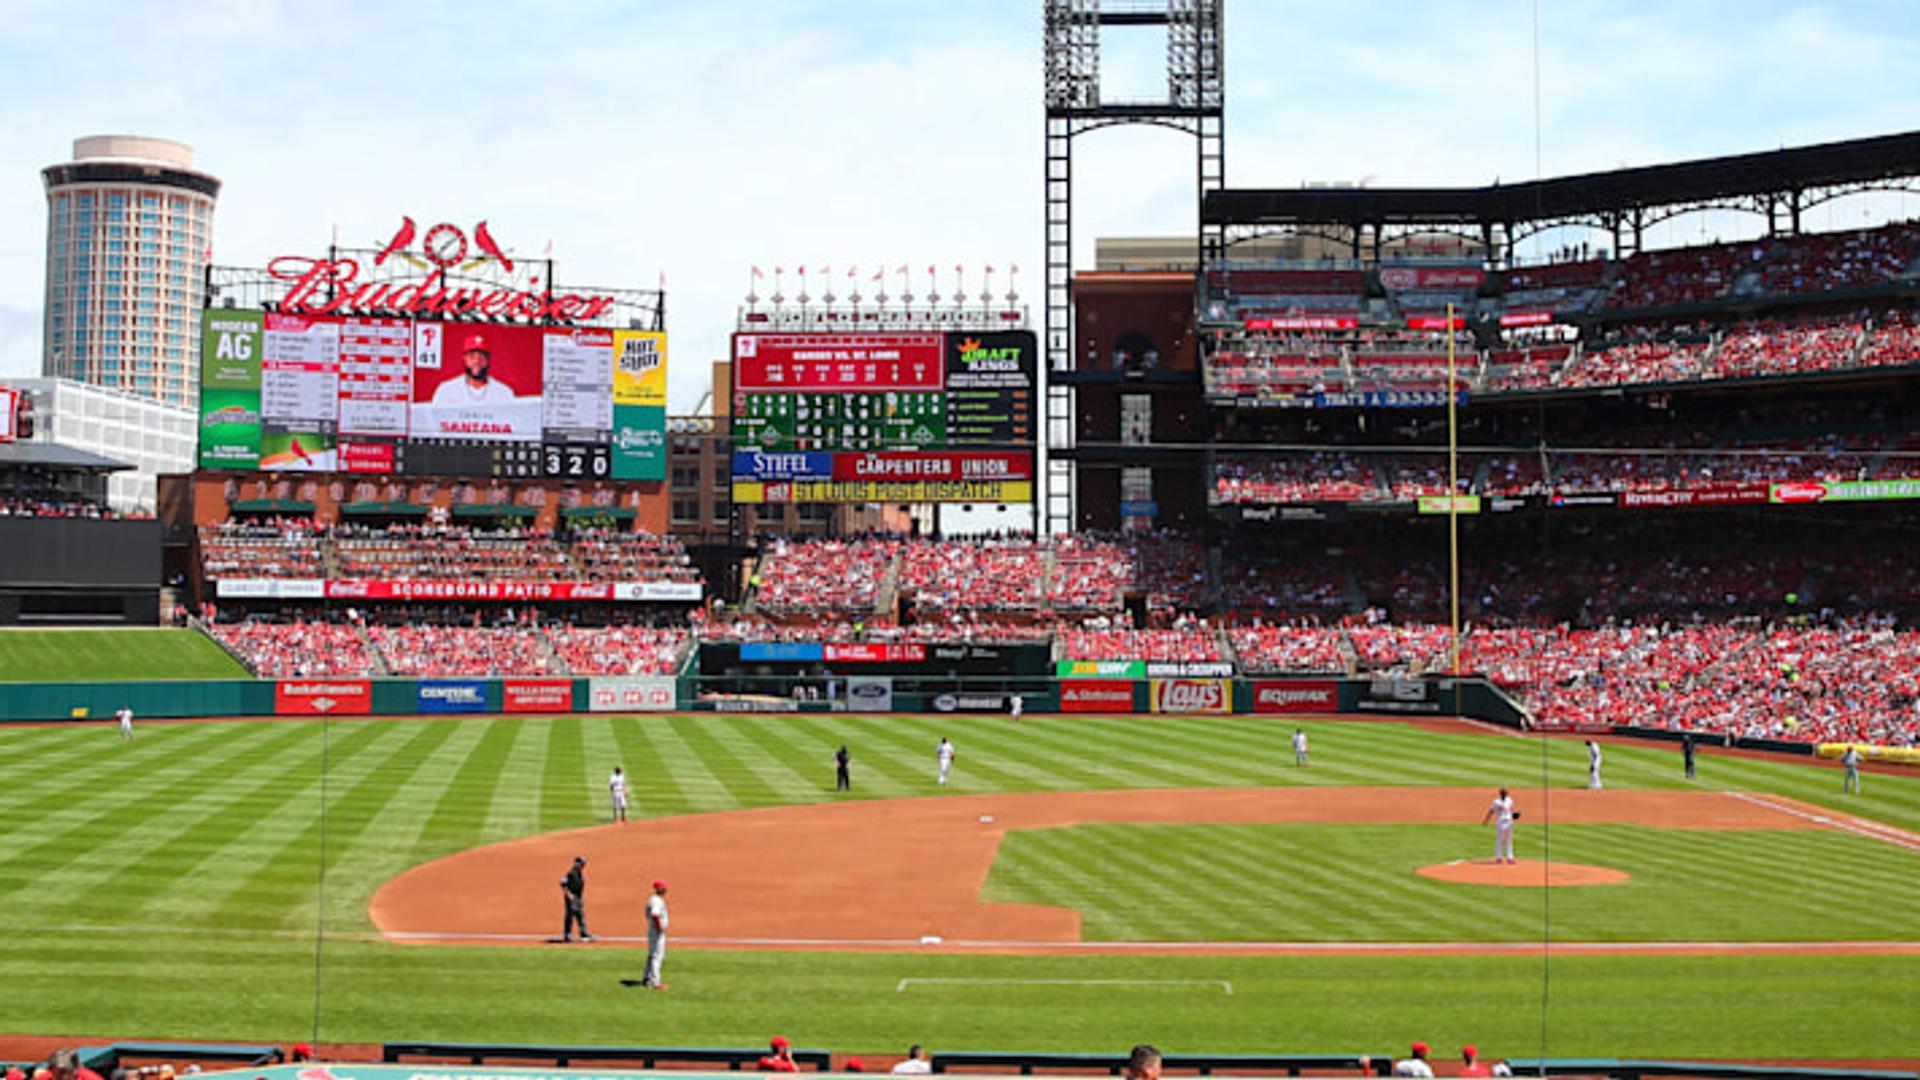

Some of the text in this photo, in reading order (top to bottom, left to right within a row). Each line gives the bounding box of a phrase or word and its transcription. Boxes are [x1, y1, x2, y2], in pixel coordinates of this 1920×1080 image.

[267, 257, 614, 321] Budweiser
[215, 332, 252, 360] AG
[625, 339, 655, 354] HOT
[418, 353, 438, 364] 41
[619, 353, 660, 372] SHOT
[961, 348, 1021, 362] DRAFT
[968, 360, 1019, 371] KINGS
[440, 421, 513, 434] SANTANA
[546, 455, 607, 475] 3 2 0
[753, 453, 812, 473] STIFEL
[855, 458, 1008, 475] CARPENTERS UNION
[823, 481, 868, 499] LOUIS
[876, 481, 1001, 499] POST-DISPATCH
[391, 584, 552, 597] SCOREBOARD PATIO
[1071, 662, 1132, 675] SUBWAY
[1259, 689, 1330, 705] EQUIFAX
